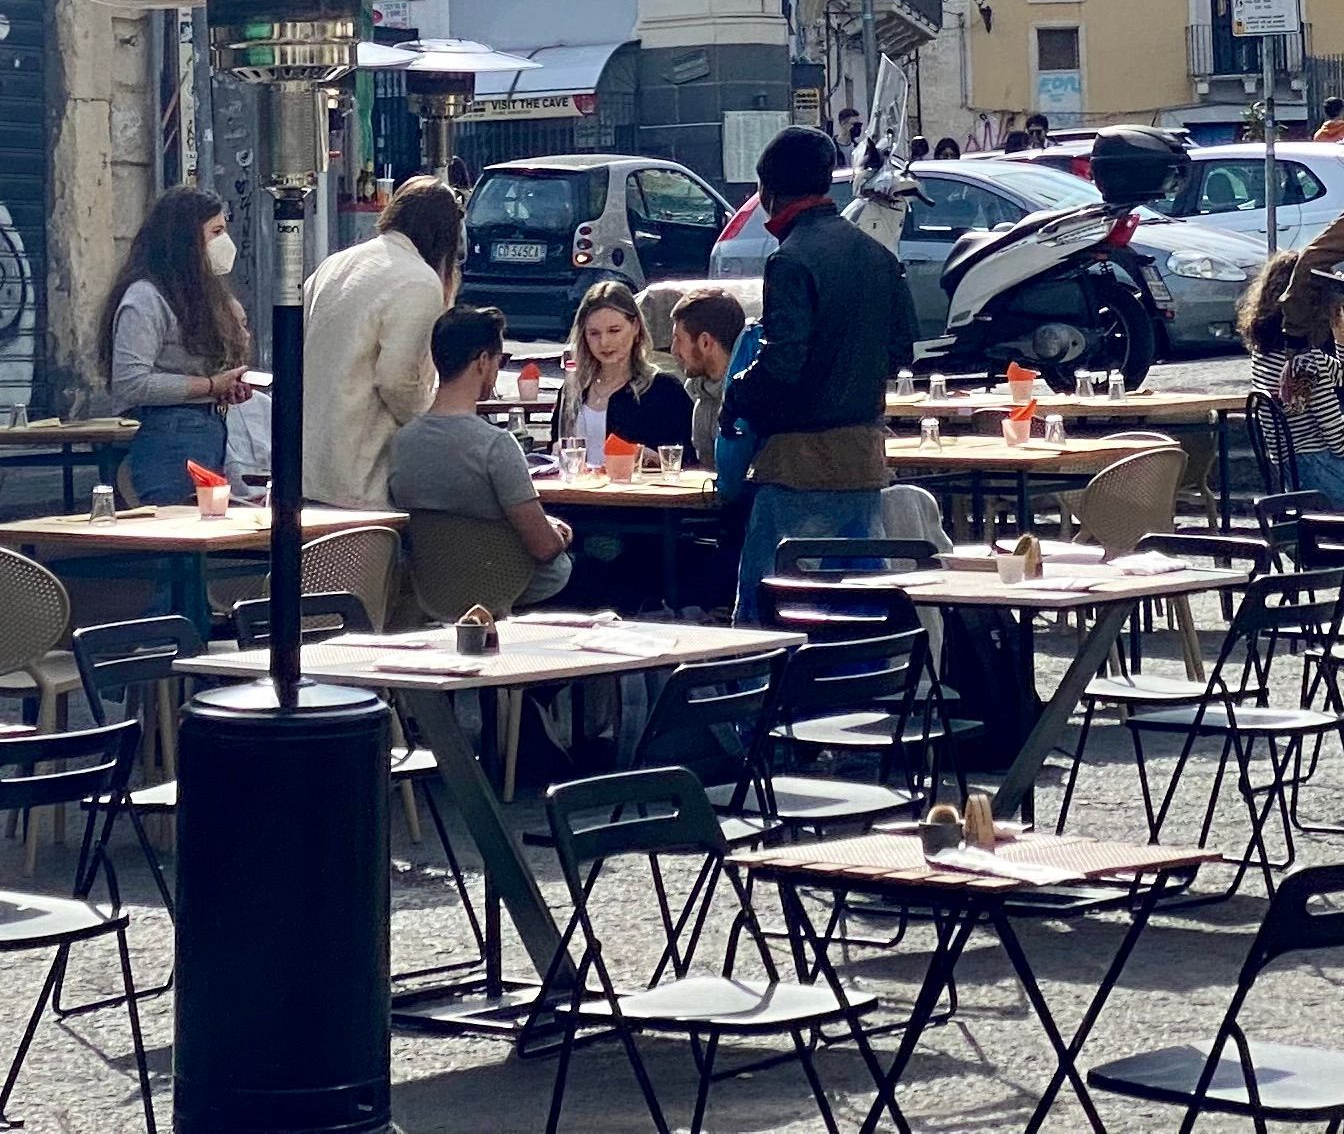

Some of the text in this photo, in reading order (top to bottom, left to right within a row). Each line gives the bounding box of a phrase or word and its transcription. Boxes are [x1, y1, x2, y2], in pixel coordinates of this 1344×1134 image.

[491, 99, 516, 111] VISIT
[520, 98, 540, 109] THE
[542, 97, 569, 109] CAVE
